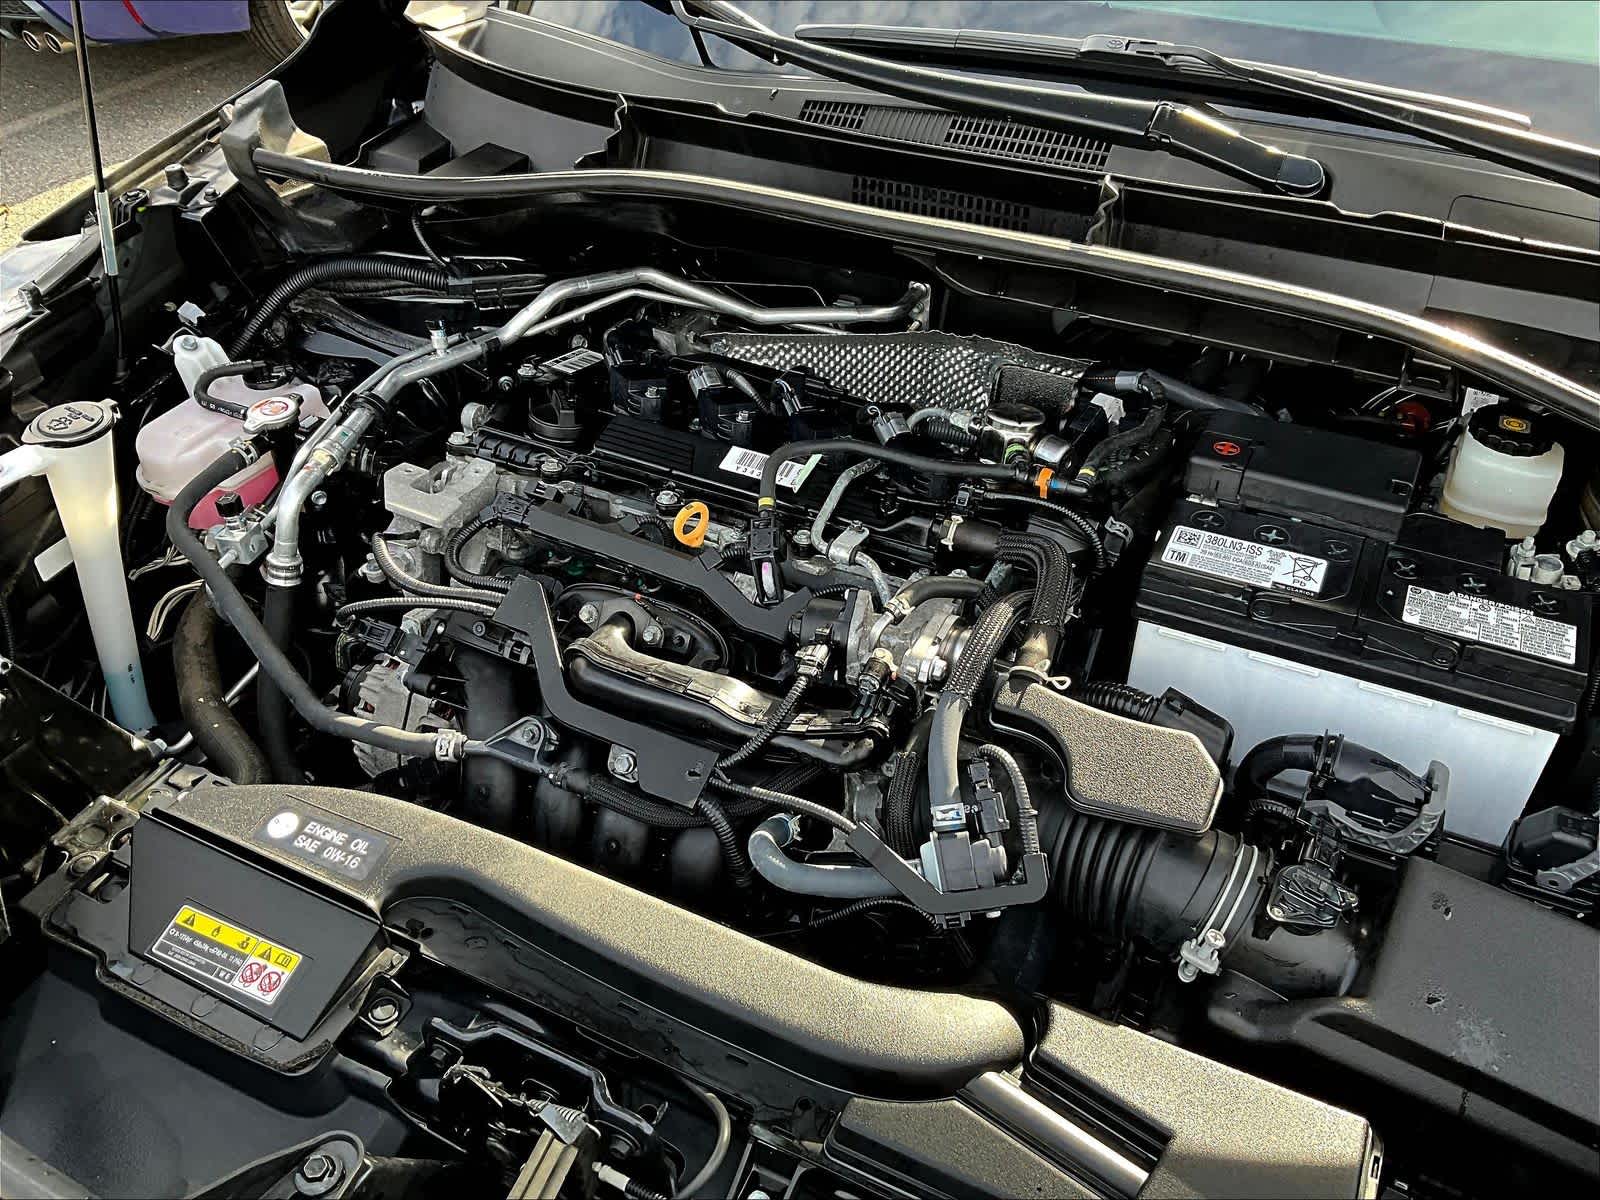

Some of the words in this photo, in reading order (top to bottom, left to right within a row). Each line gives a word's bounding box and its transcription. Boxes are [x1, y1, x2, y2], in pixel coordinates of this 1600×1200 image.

[1205, 534, 1264, 556] 380LN3-ISS
[1169, 550, 1187, 563] TM
[1293, 579, 1306, 587] Pb
[303, 821, 349, 846] ENGINE
[350, 838, 369, 855] OIL
[293, 834, 321, 853] SAE
[323, 846, 361, 869] 0W-16
